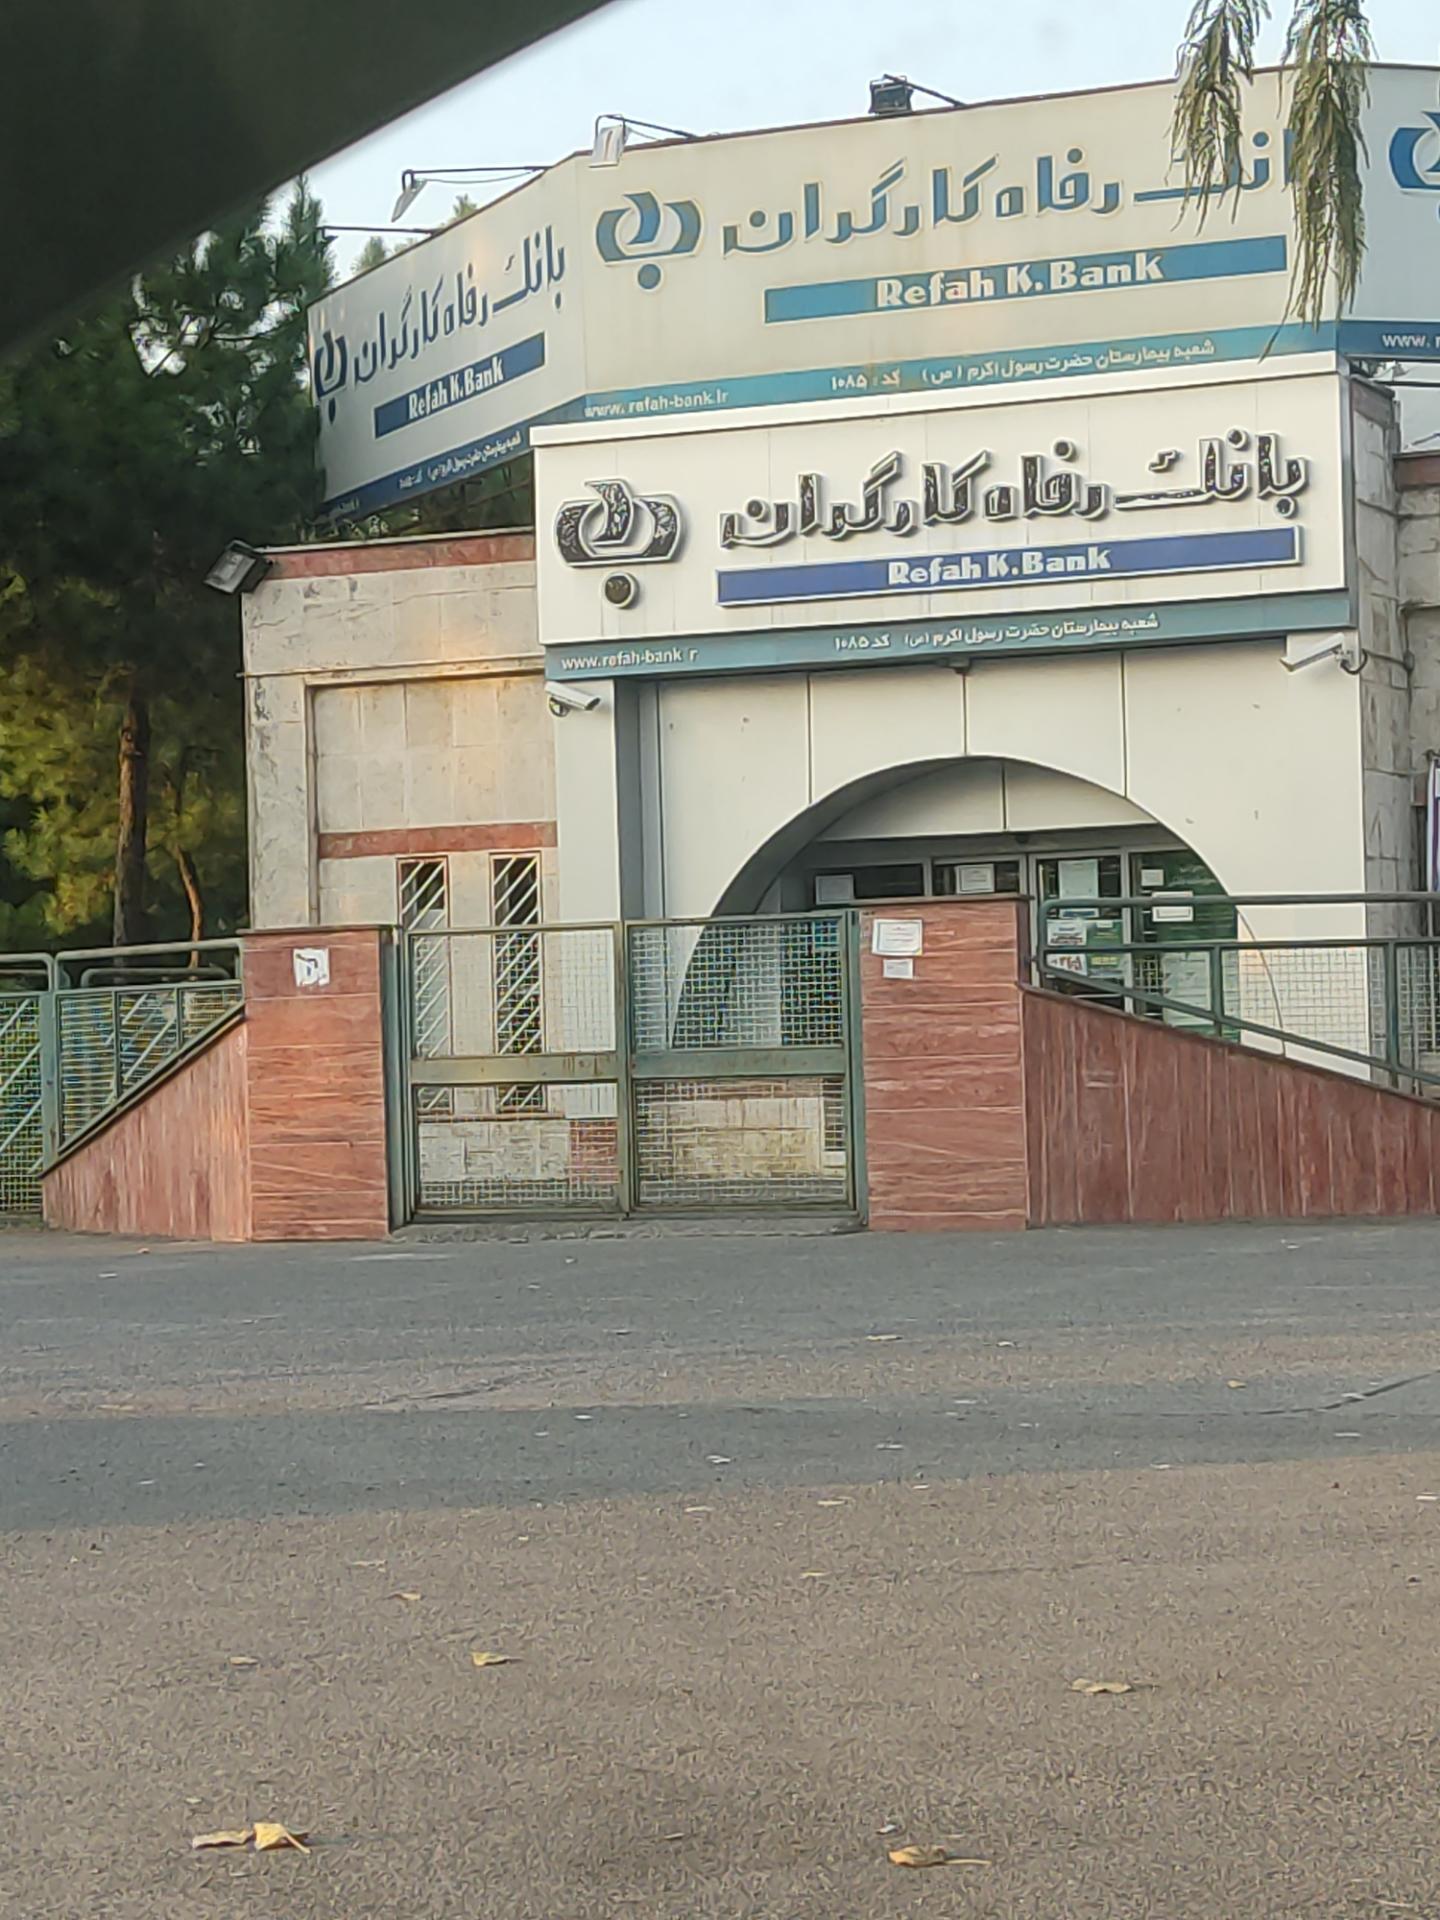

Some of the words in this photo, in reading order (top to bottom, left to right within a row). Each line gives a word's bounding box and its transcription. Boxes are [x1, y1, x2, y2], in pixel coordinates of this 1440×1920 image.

[1134, 127, 1297, 202] انک
[997, 148, 1120, 218] رفاه
[723, 154, 998, 258] کارگران
[492, 225, 565, 311] بانک
[444, 262, 488, 336] رفاه
[877, 270, 994, 307] Refah
[354, 274, 444, 385] کارگران
[1095, 346, 1171, 369] بیمارستان
[1174, 339, 1214, 360] شعبه
[967, 361, 998, 380] اکرم
[1001, 360, 1043, 377] رسول
[1044, 353, 1093, 372] حضرت
[831, 373, 867, 391] ۱۰۸۵
[408, 380, 448, 419] Refah
[983, 438, 1109, 522] رفاه
[1115, 428, 1308, 517] بانک
[719, 449, 990, 550] کارگران
[888, 556, 982, 585] Refah
[964, 626, 1003, 643] رسول
[1006, 622, 1050, 641] حضرت
[1051, 618, 1119, 639] بیمارستان
[1121, 613, 1159, 635] شعبه
[835, 636, 869, 650] ۱۰۸۵
[871, 633, 890, 648] کد
[932, 628, 962, 646] اکرم
